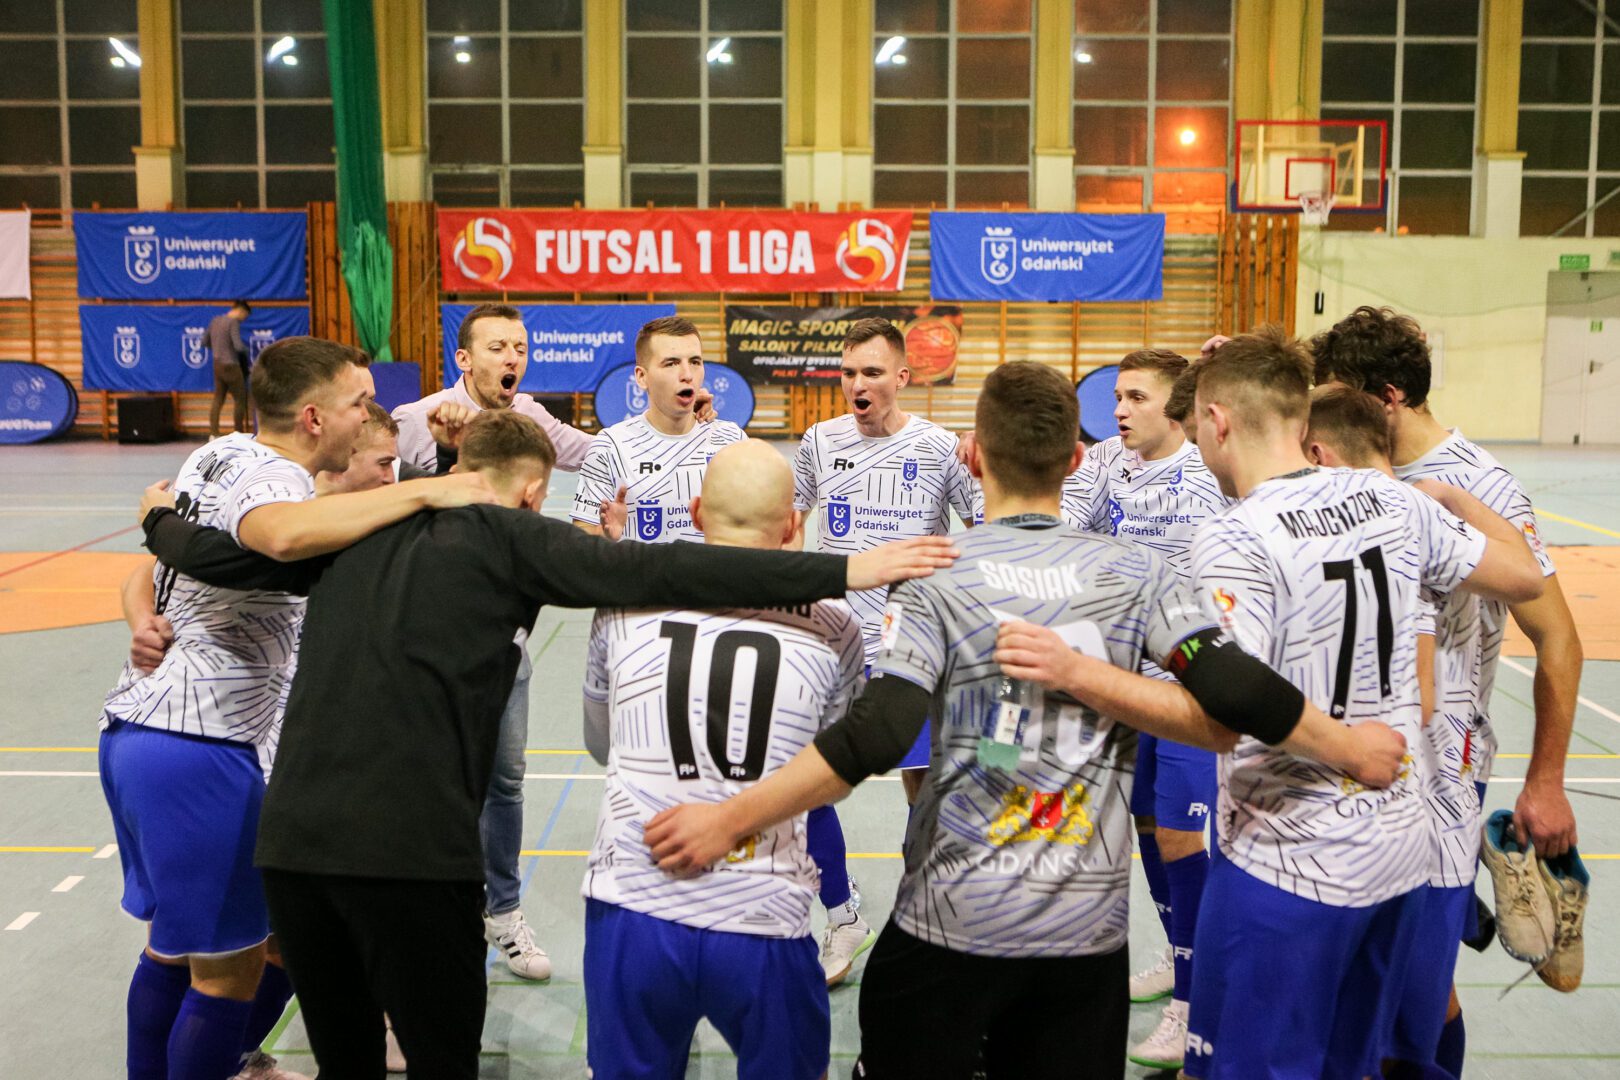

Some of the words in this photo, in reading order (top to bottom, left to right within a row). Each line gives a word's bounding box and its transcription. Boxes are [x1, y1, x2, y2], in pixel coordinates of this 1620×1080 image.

[164, 236, 256, 255] Uniwersytet
[535, 229, 682, 274] FUTSAL
[696, 230, 712, 273] 1
[728, 229, 816, 274] LIGA
[1021, 237, 1114, 256] Uniwersytet
[164, 254, 227, 270] Gdański
[1021, 255, 1083, 271] Gdański
[532, 329, 625, 348] Uniwersytet
[738, 339, 799, 352] SALONY
[532, 347, 595, 362] Gdański
[855, 506, 923, 520] Uniwersytet
[1127, 512, 1191, 525] Uniwersytet
[855, 520, 899, 531] Gdański
[1121, 524, 1166, 537] Gdański
[977, 560, 1085, 600] SASIAK
[1323, 545, 1392, 719] 71
[659, 620, 781, 781] 10
